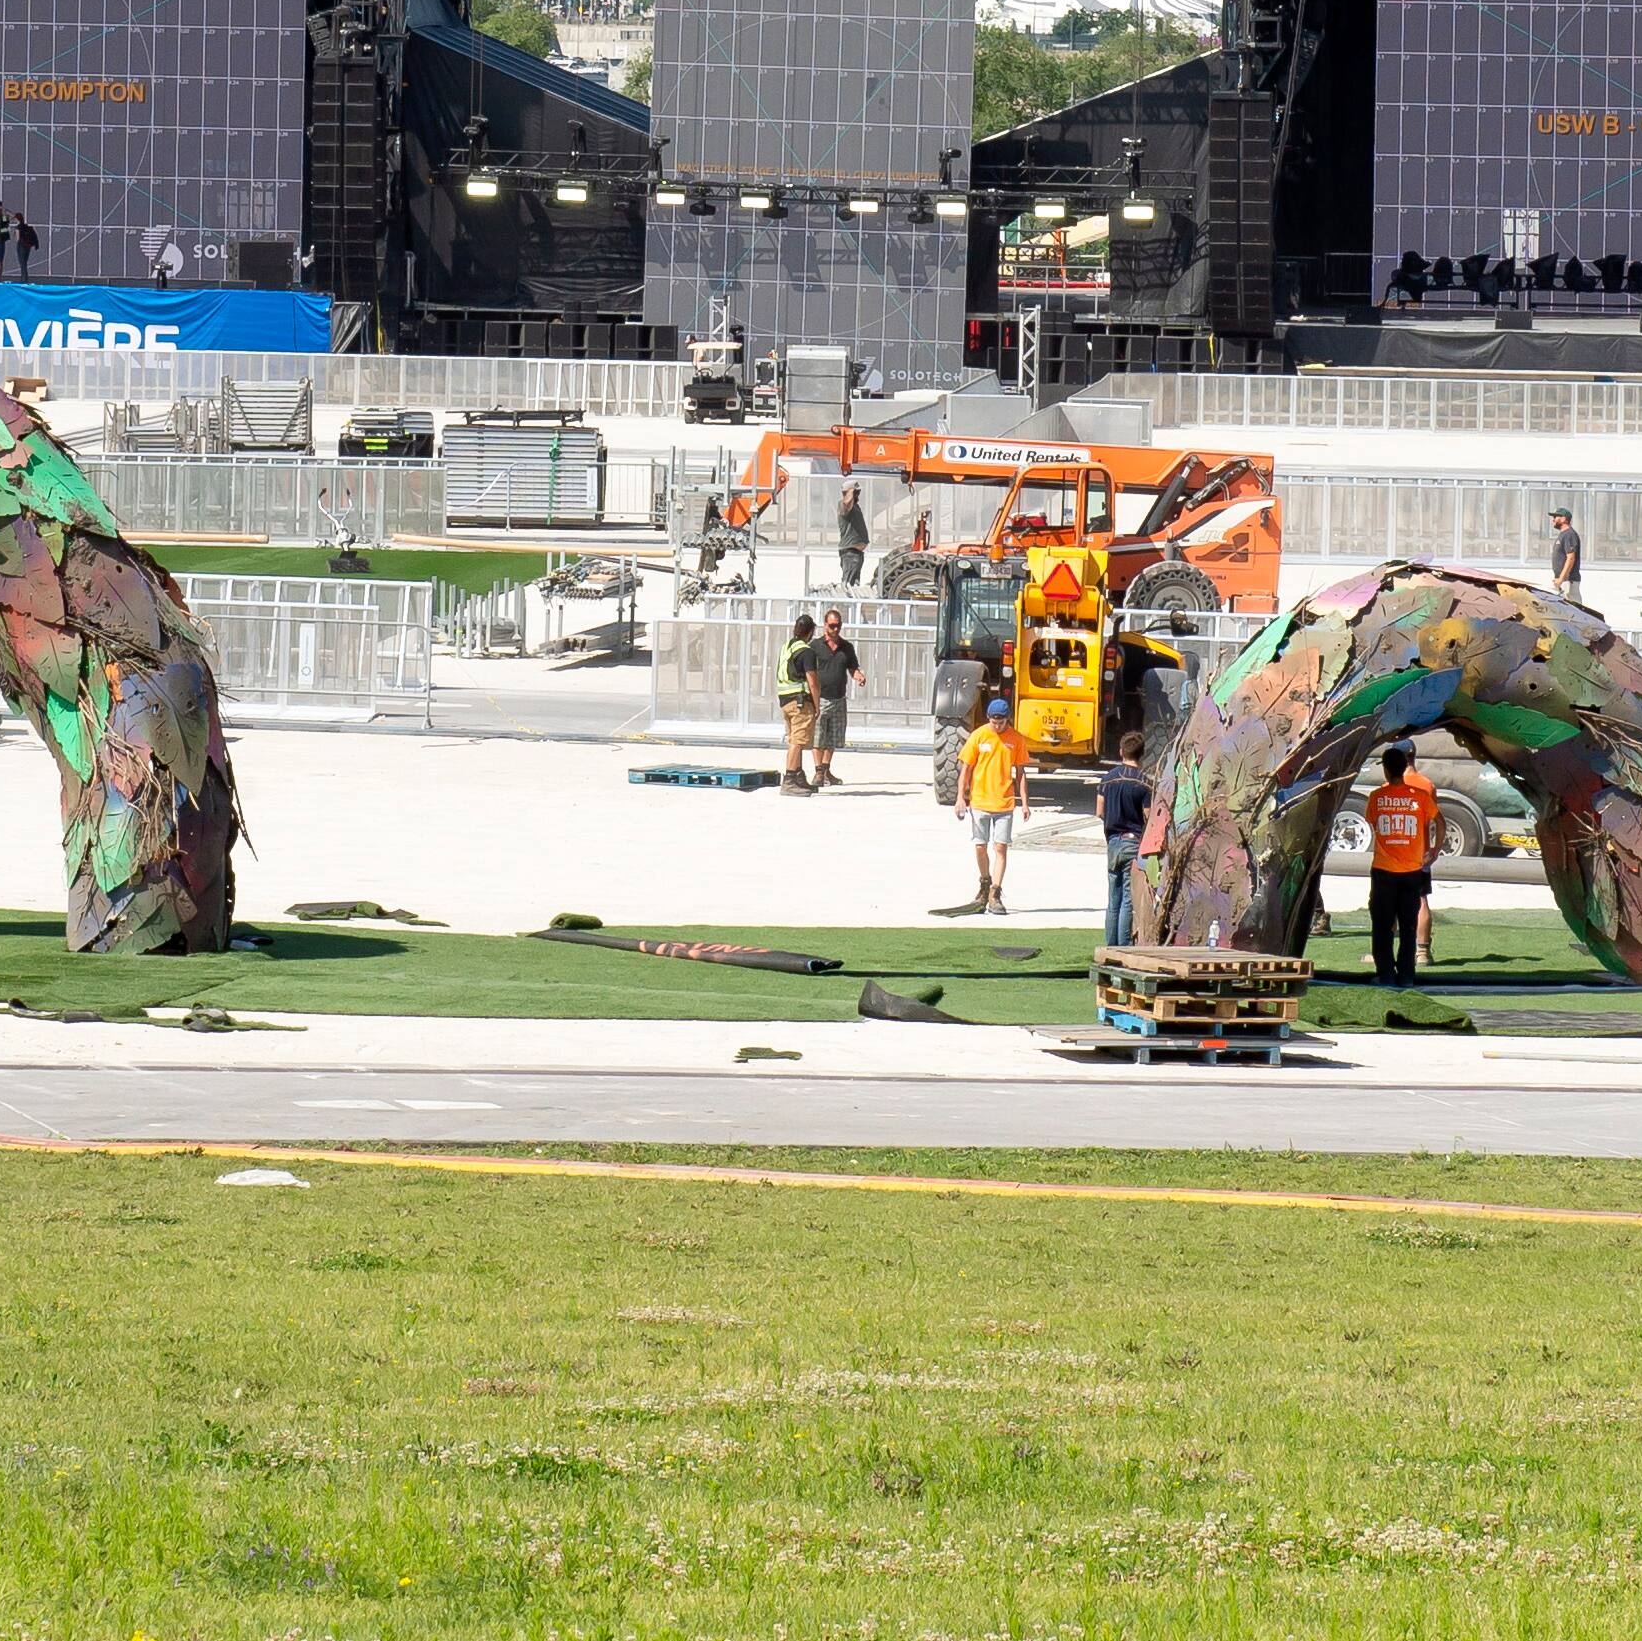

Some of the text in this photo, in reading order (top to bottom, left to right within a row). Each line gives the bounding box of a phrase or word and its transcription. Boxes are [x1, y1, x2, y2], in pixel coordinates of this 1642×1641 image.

[5, 80, 146, 103] BROMPTON
[1537, 113, 1595, 135] USW
[1602, 115, 1621, 136] B
[889, 369, 962, 382] SOLOTECH
[971, 446, 1082, 465] United Rentals
[1377, 795, 1412, 807] shaw
[1378, 814, 1417, 836] GTR
